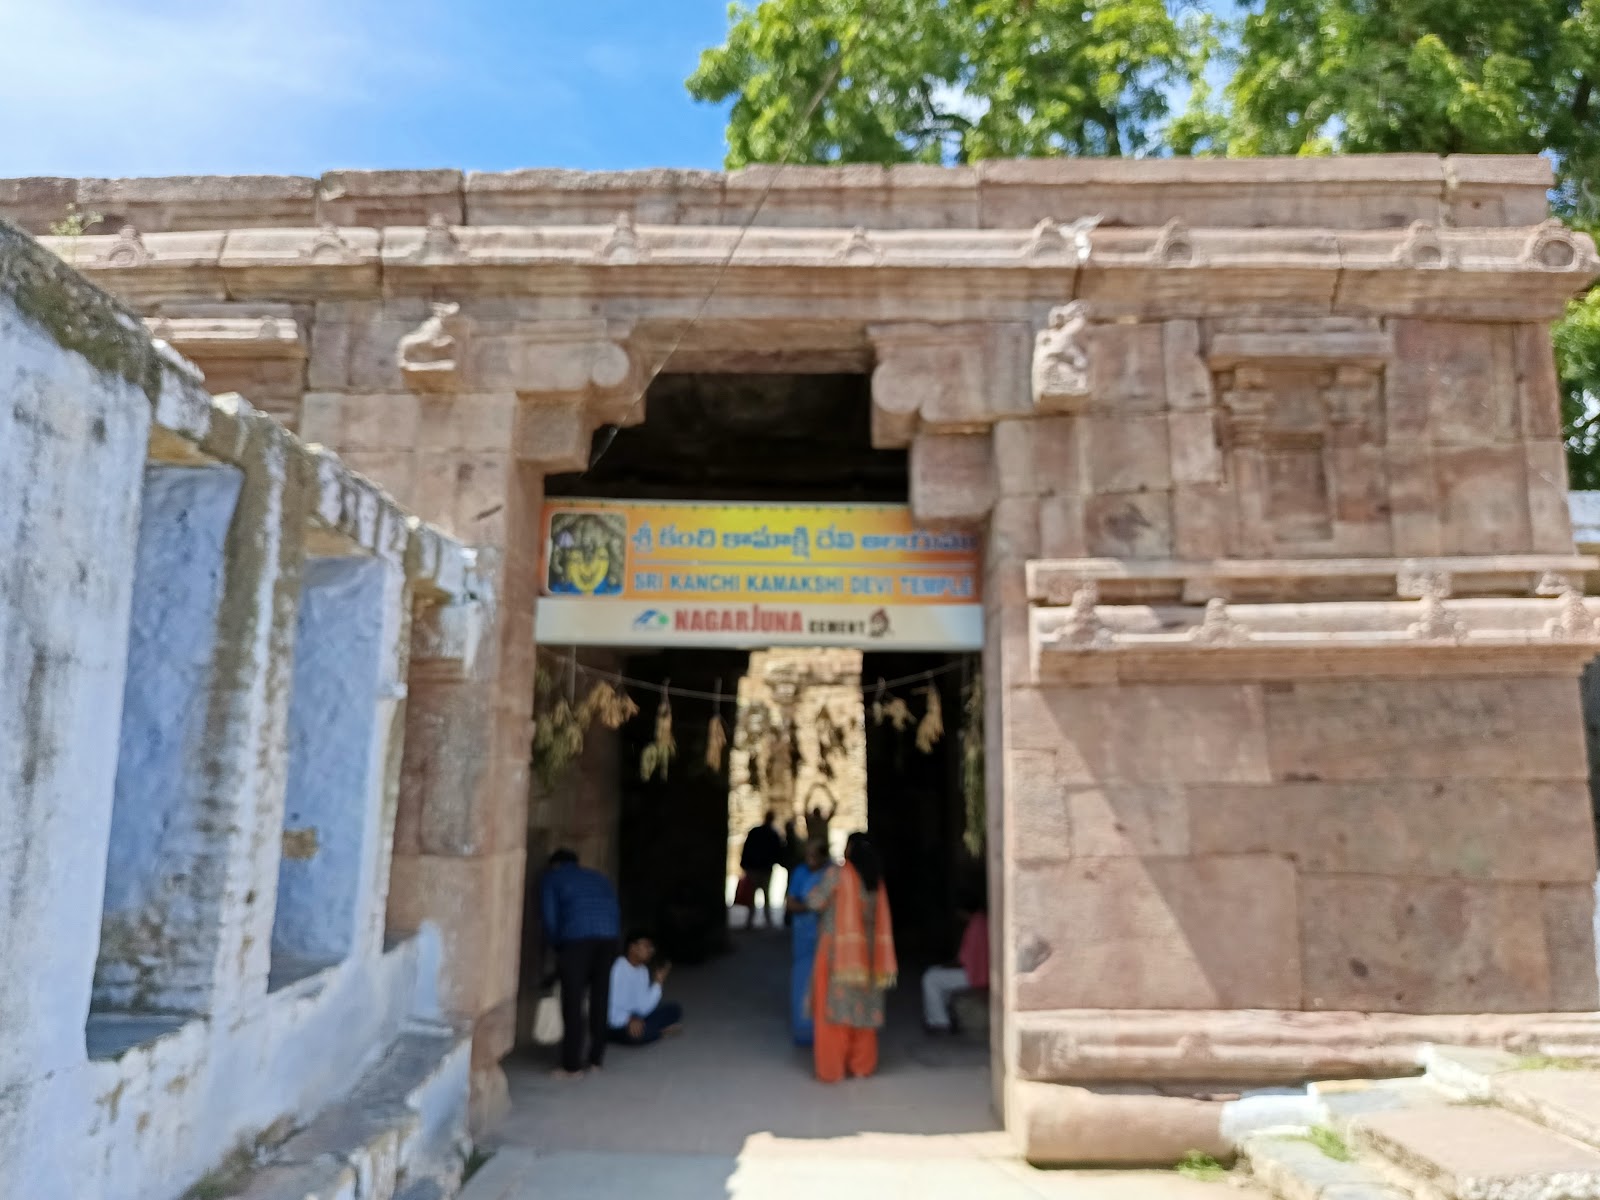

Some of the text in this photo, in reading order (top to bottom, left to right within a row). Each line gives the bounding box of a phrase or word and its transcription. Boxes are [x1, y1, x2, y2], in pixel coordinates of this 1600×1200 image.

[634, 572, 972, 596] SRI KANCHI KAMAKSHI DEVI TEMPLE
[674, 603, 865, 634] NAGARJUNA CEMENT
